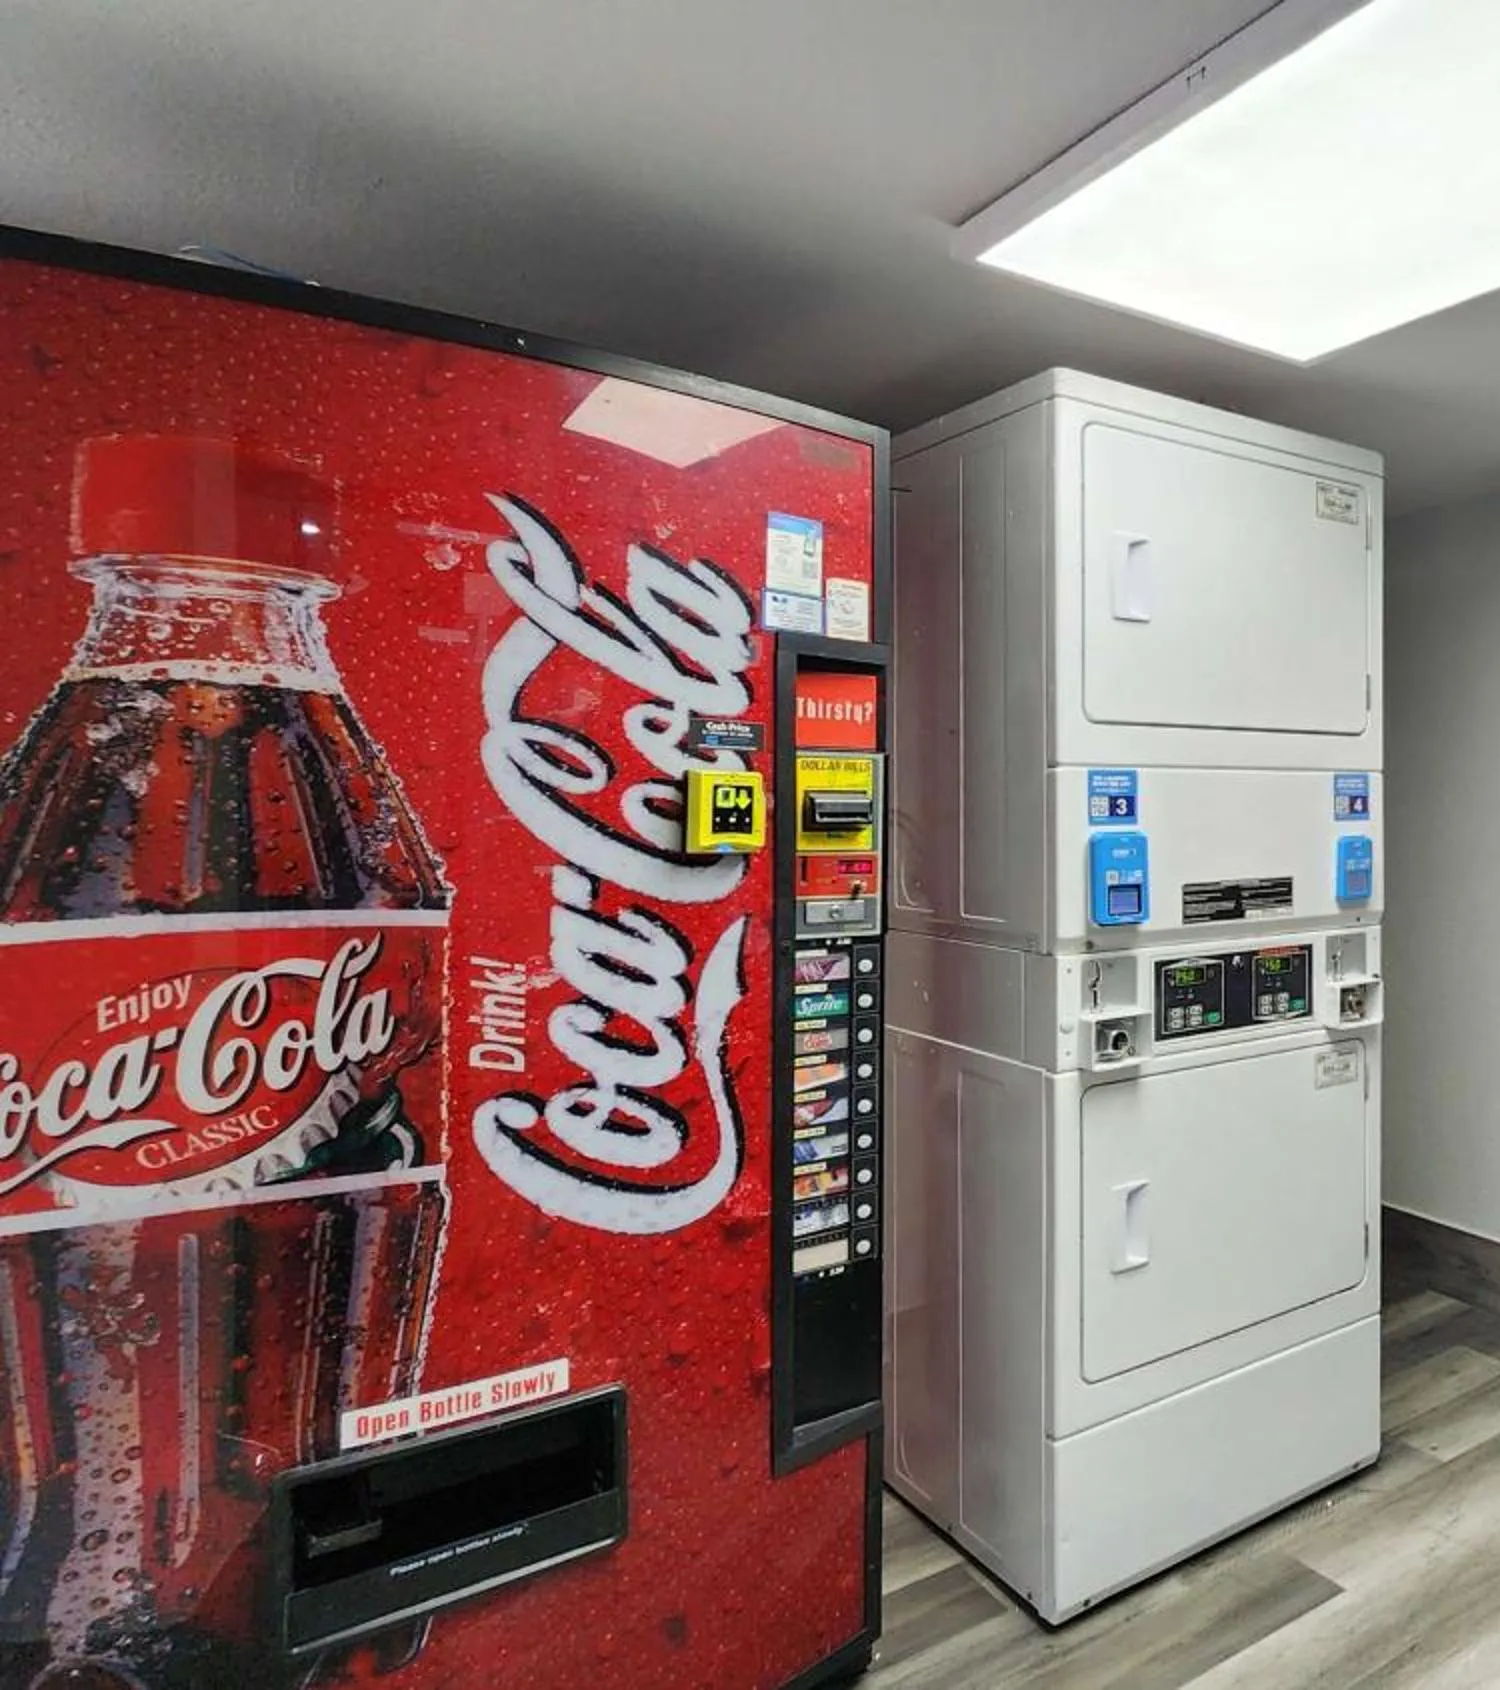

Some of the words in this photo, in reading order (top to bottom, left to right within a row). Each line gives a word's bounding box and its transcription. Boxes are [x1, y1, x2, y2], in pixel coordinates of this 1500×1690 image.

[796, 695, 873, 726] Thirsty?
[1115, 798, 1128, 815] 3
[1353, 798, 1363, 812] 4
[472, 490, 756, 1234] Coca-Cola
[96, 974, 194, 1033] Enjoy
[468, 956, 528, 1075] Drink!
[798, 993, 843, 1017] Sprite
[0, 930, 396, 1190] oca-Cola
[135, 1104, 280, 1171] CLASSIC
[356, 1408, 410, 1440] Open
[419, 1387, 483, 1421] Bottle
[491, 1368, 557, 1405] Slowly
